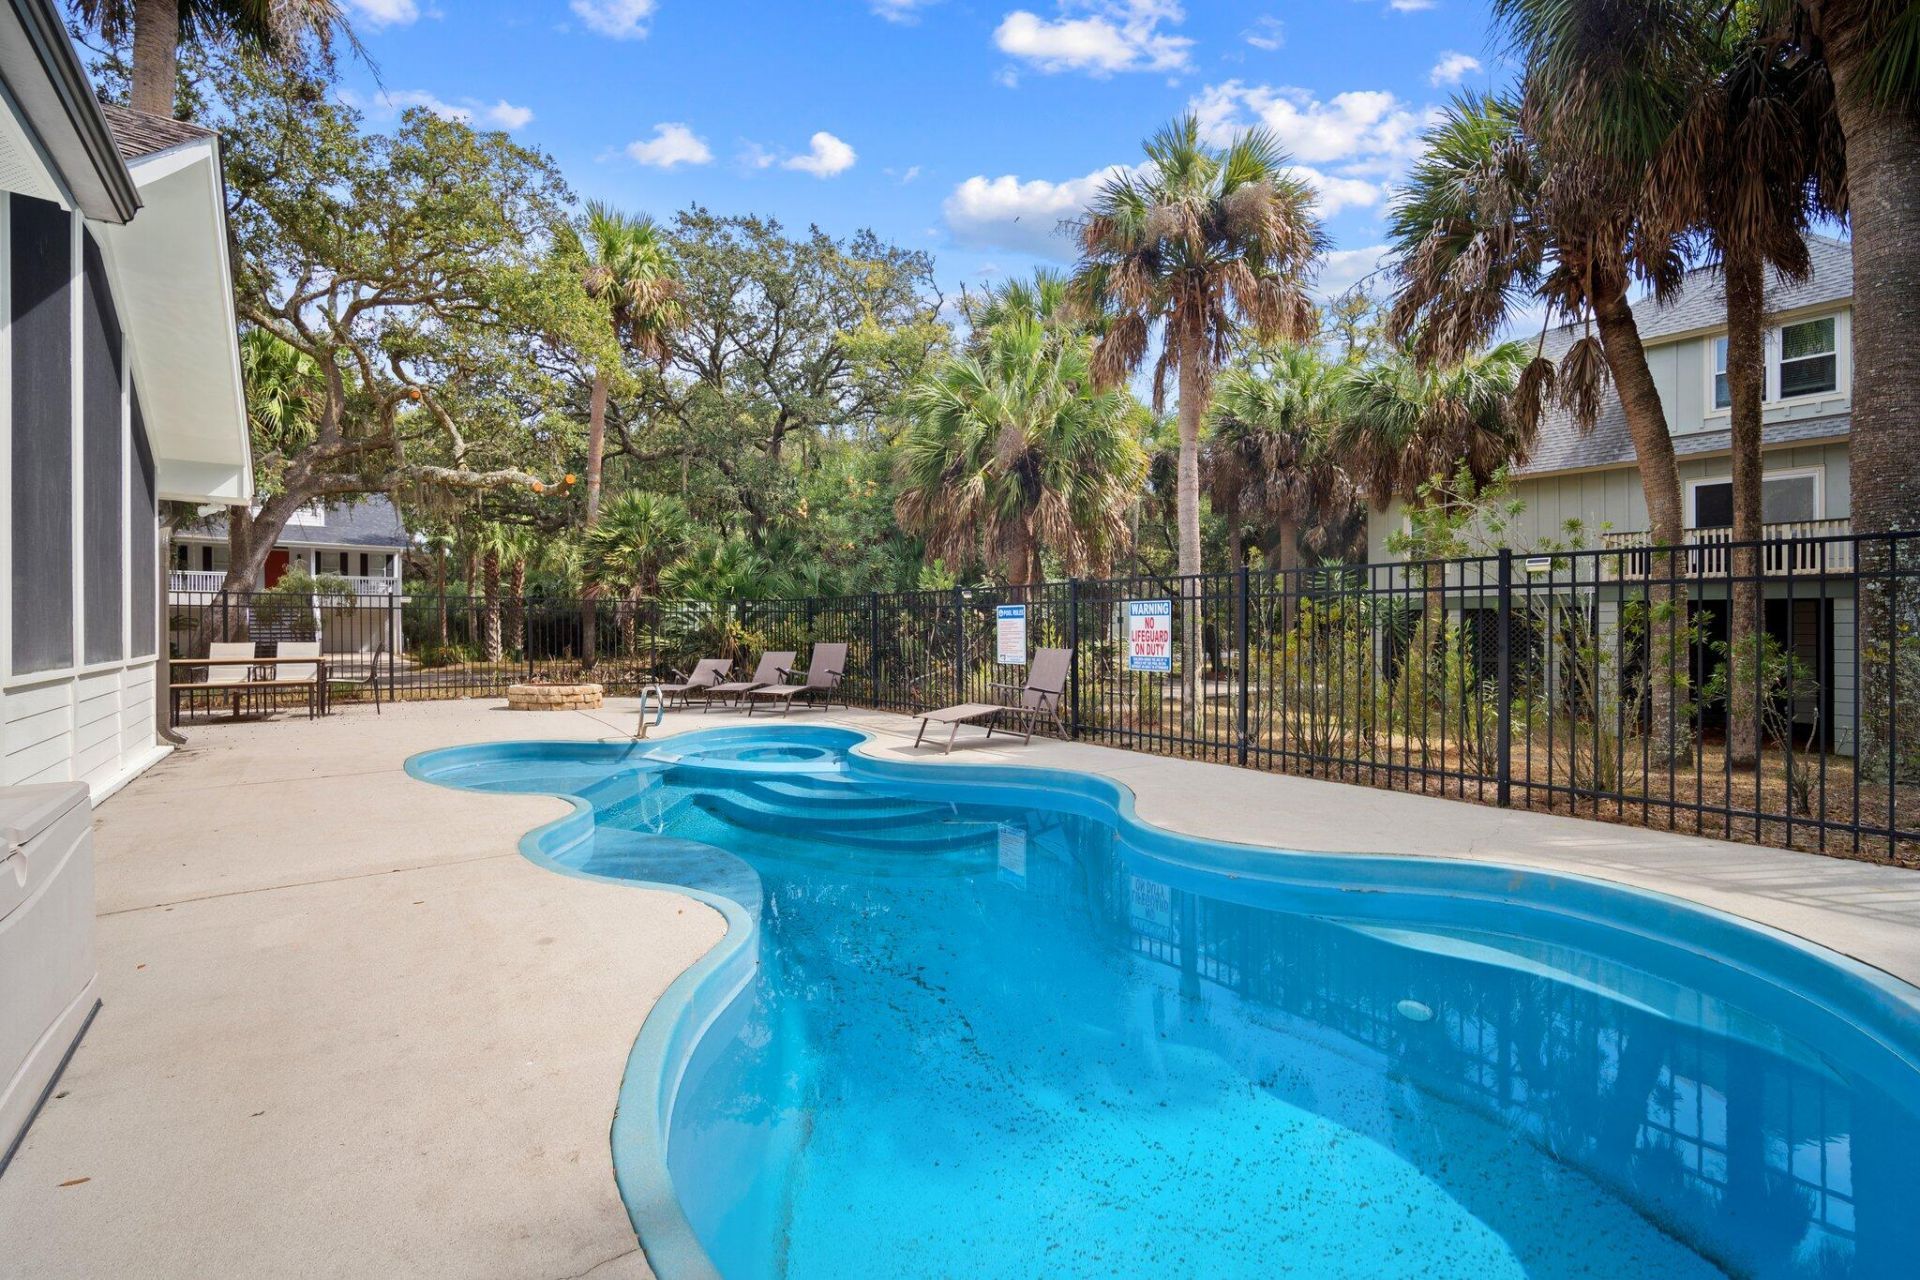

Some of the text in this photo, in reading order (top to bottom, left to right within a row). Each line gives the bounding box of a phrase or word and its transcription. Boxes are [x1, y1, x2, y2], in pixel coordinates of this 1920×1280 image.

[1131, 603, 1168, 615] WARNING
[1144, 617, 1155, 629] NO
[1131, 631, 1168, 642] LIFEGUARD
[1135, 643, 1165, 656] ON DUTY
